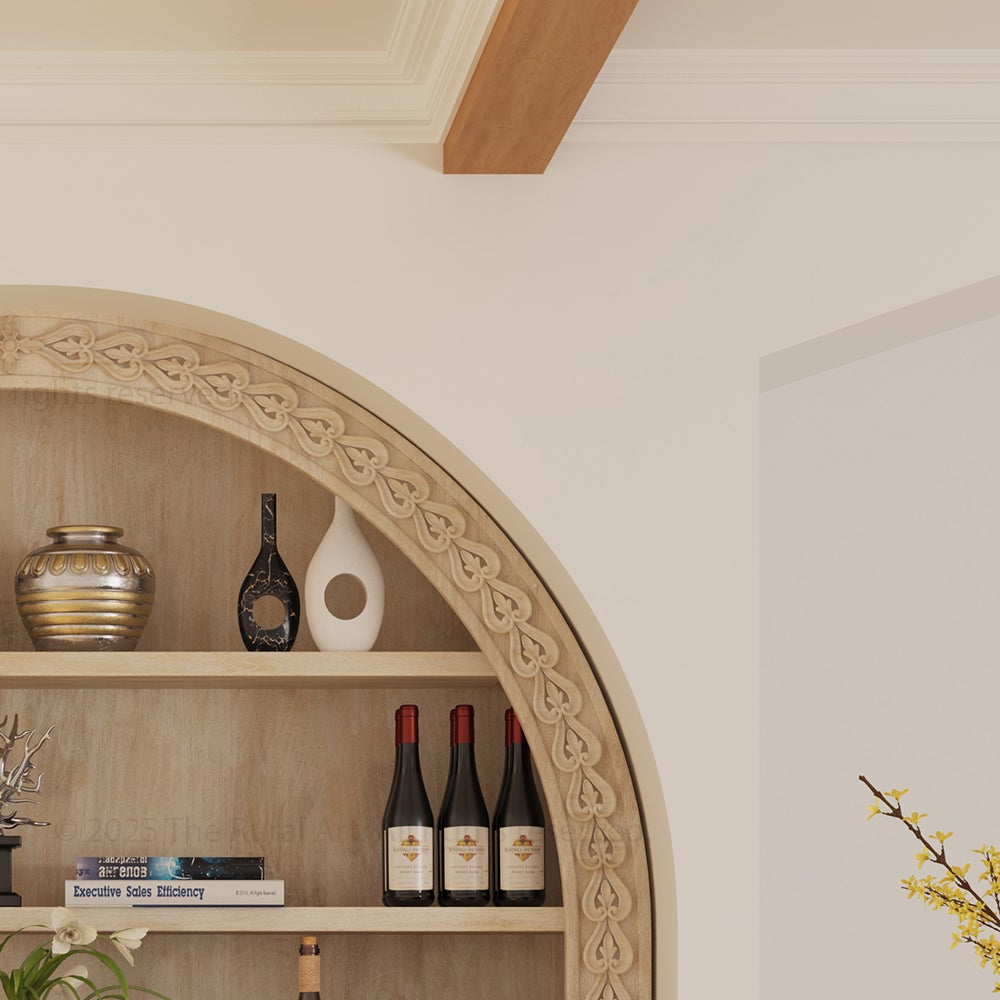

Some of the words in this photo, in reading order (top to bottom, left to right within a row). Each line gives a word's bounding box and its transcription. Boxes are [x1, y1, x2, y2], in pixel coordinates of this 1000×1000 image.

[74, 886, 122, 898] Executive
[126, 886, 152, 898] Sales
[157, 886, 205, 900] Efficiency
